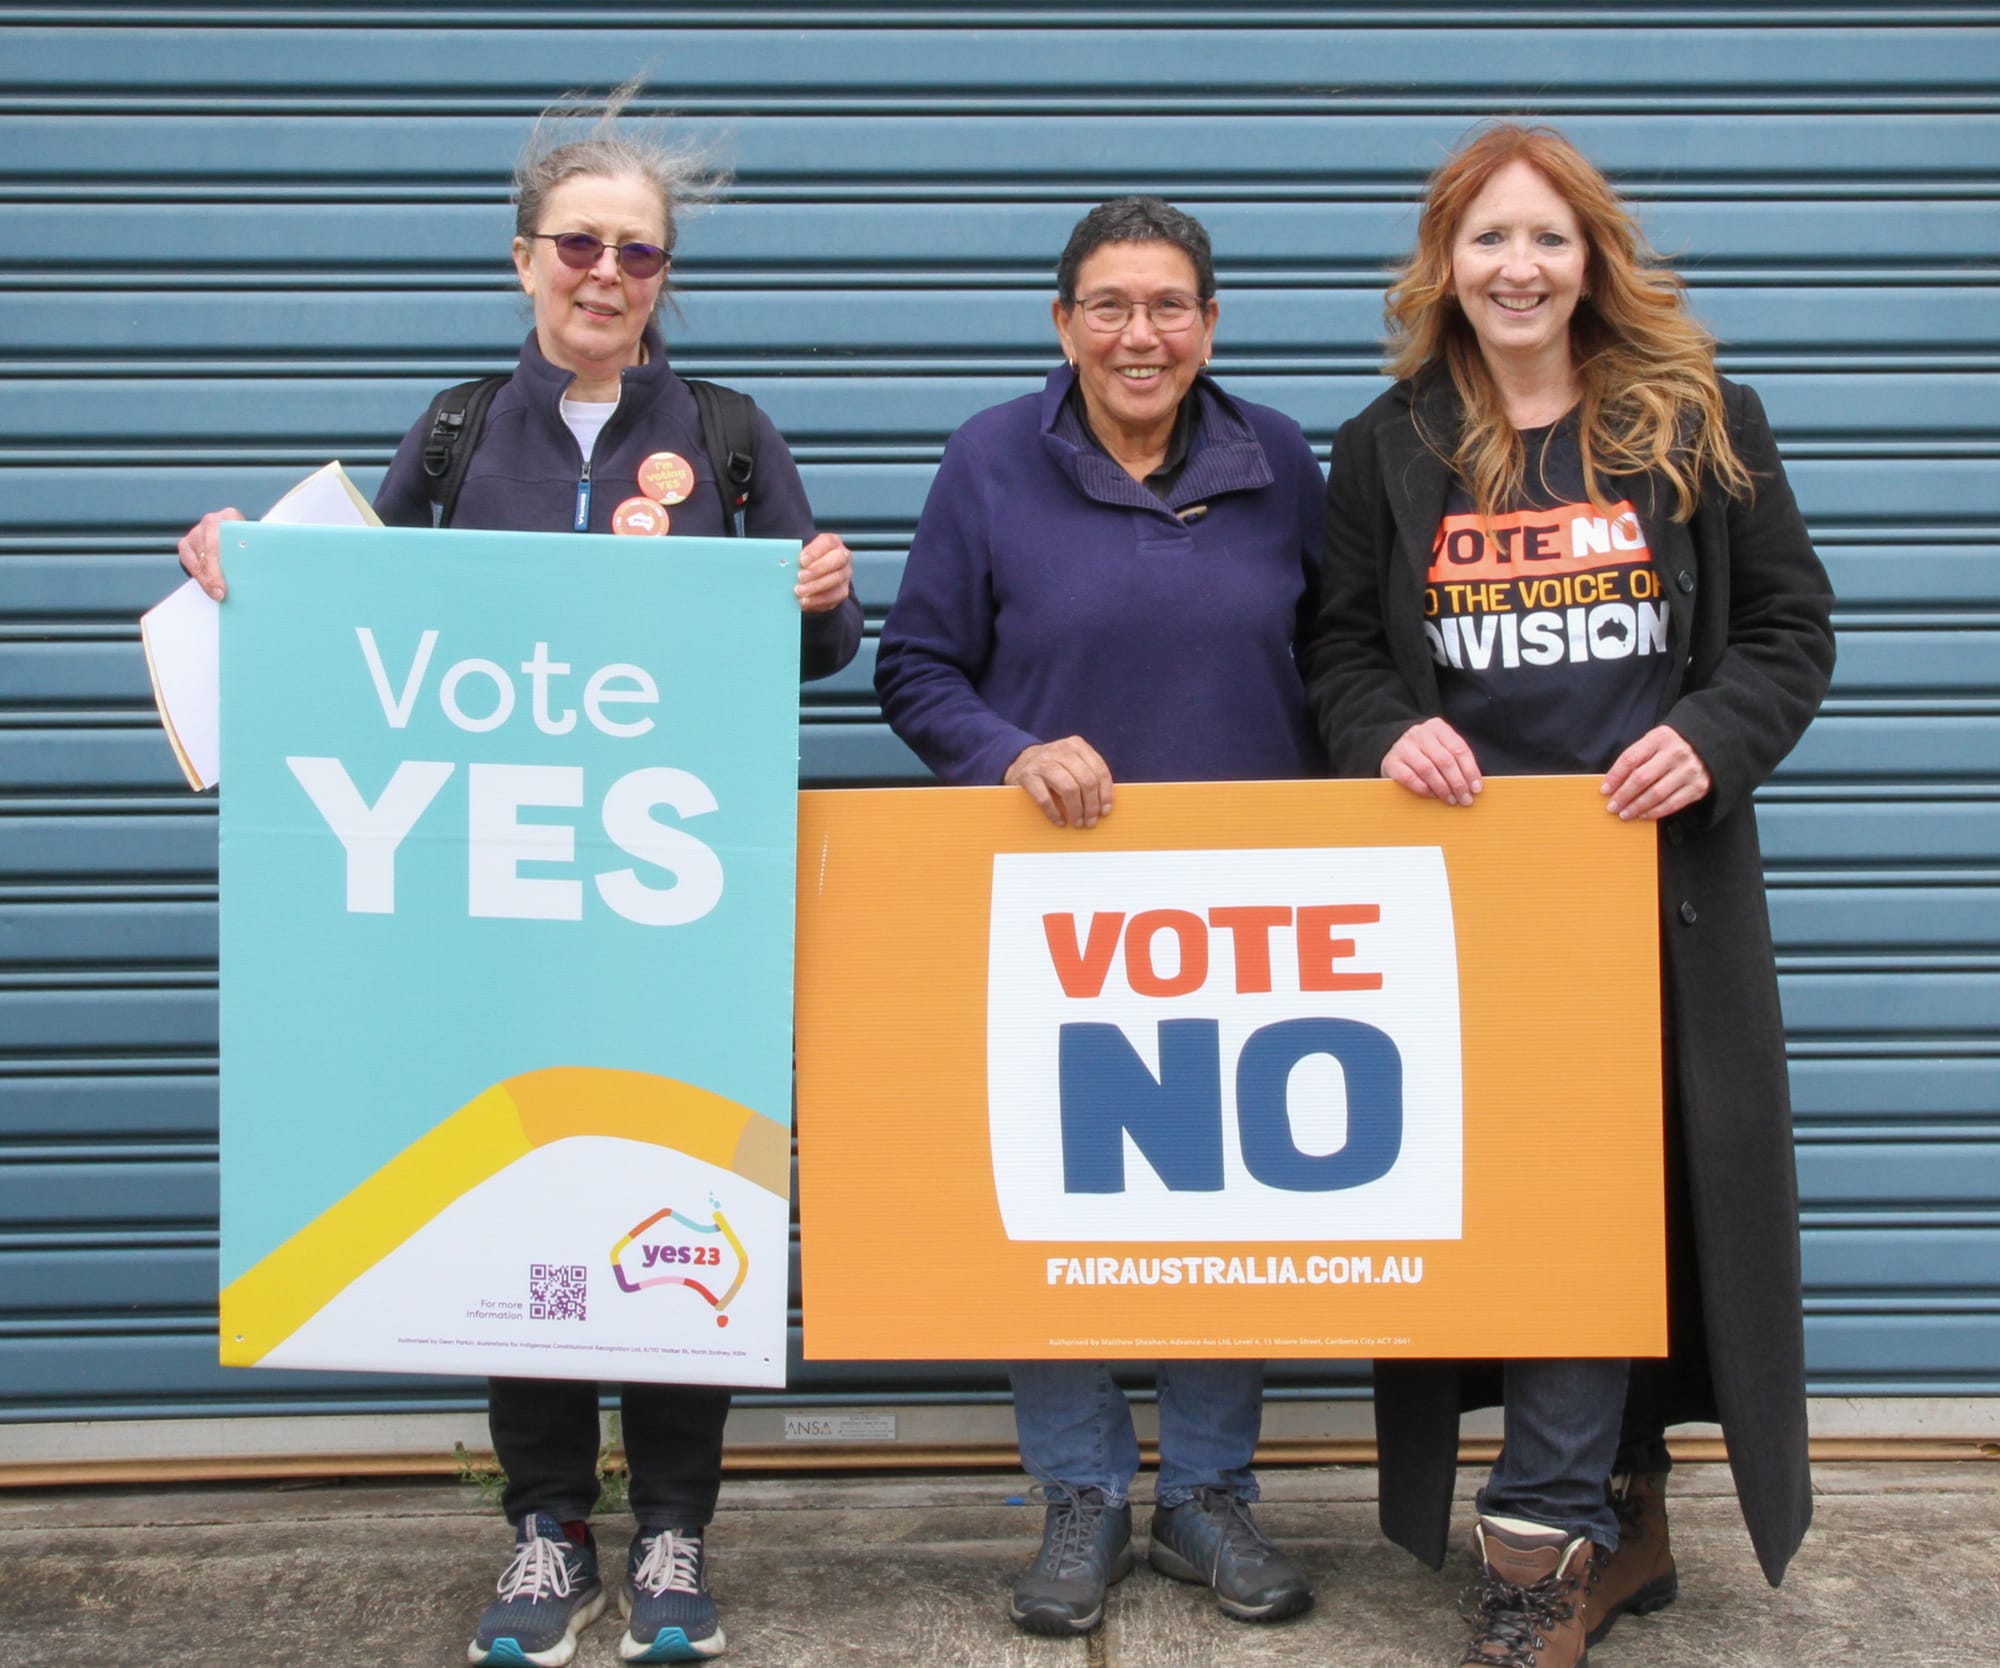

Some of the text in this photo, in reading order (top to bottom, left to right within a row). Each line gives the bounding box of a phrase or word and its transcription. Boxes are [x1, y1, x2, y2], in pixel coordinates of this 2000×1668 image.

[646, 469, 686, 481] voting
[655, 461, 673, 470] I'm
[655, 479, 681, 491] YES
[1572, 512, 1646, 557] NO
[1445, 583, 1511, 613] THE
[1519, 571, 1621, 606] VOICE
[355, 627, 660, 738] Vote
[285, 756, 724, 927] YES
[1043, 904, 1383, 998] VOTE
[1059, 1017, 1404, 1194] NO
[1047, 1256, 1424, 1286] FAIRAUSTRALIA.COM.AU
[466, 1309, 523, 1320] information
[480, 1299, 523, 1310] For more
